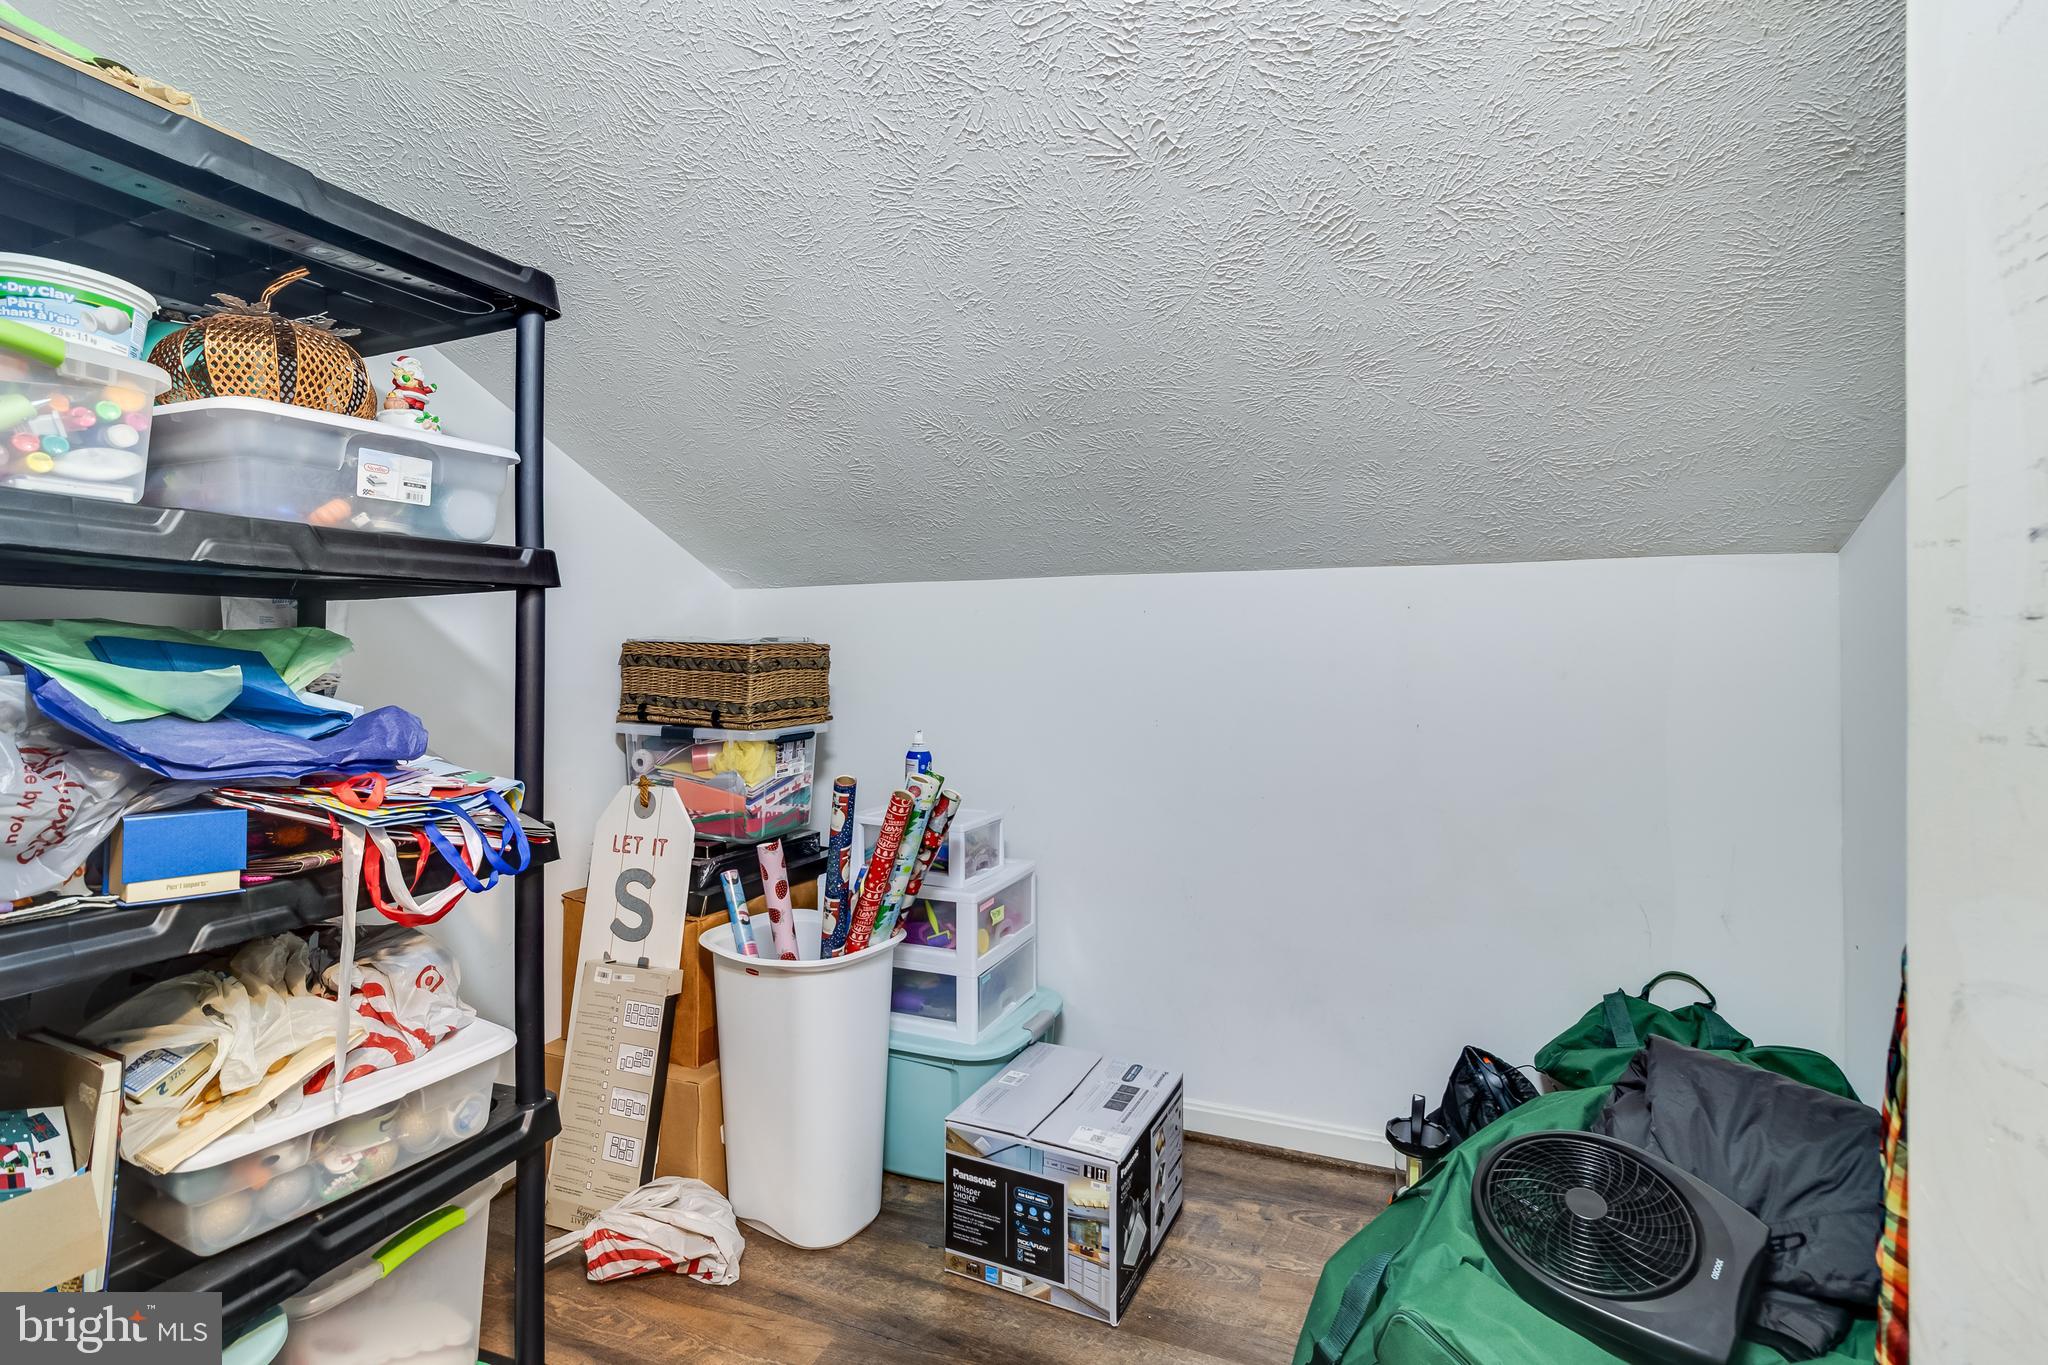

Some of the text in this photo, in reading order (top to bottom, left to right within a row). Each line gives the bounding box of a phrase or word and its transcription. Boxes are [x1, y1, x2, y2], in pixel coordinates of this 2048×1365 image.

[38, 286, 75, 303] Clay
[0, 305, 36, 319] hant
[16, 791, 43, 810] by
[612, 834, 669, 857] LET IT
[609, 867, 656, 942] S
[952, 1167, 997, 1188] Panasonic
[952, 1182, 981, 1196] Whisper
